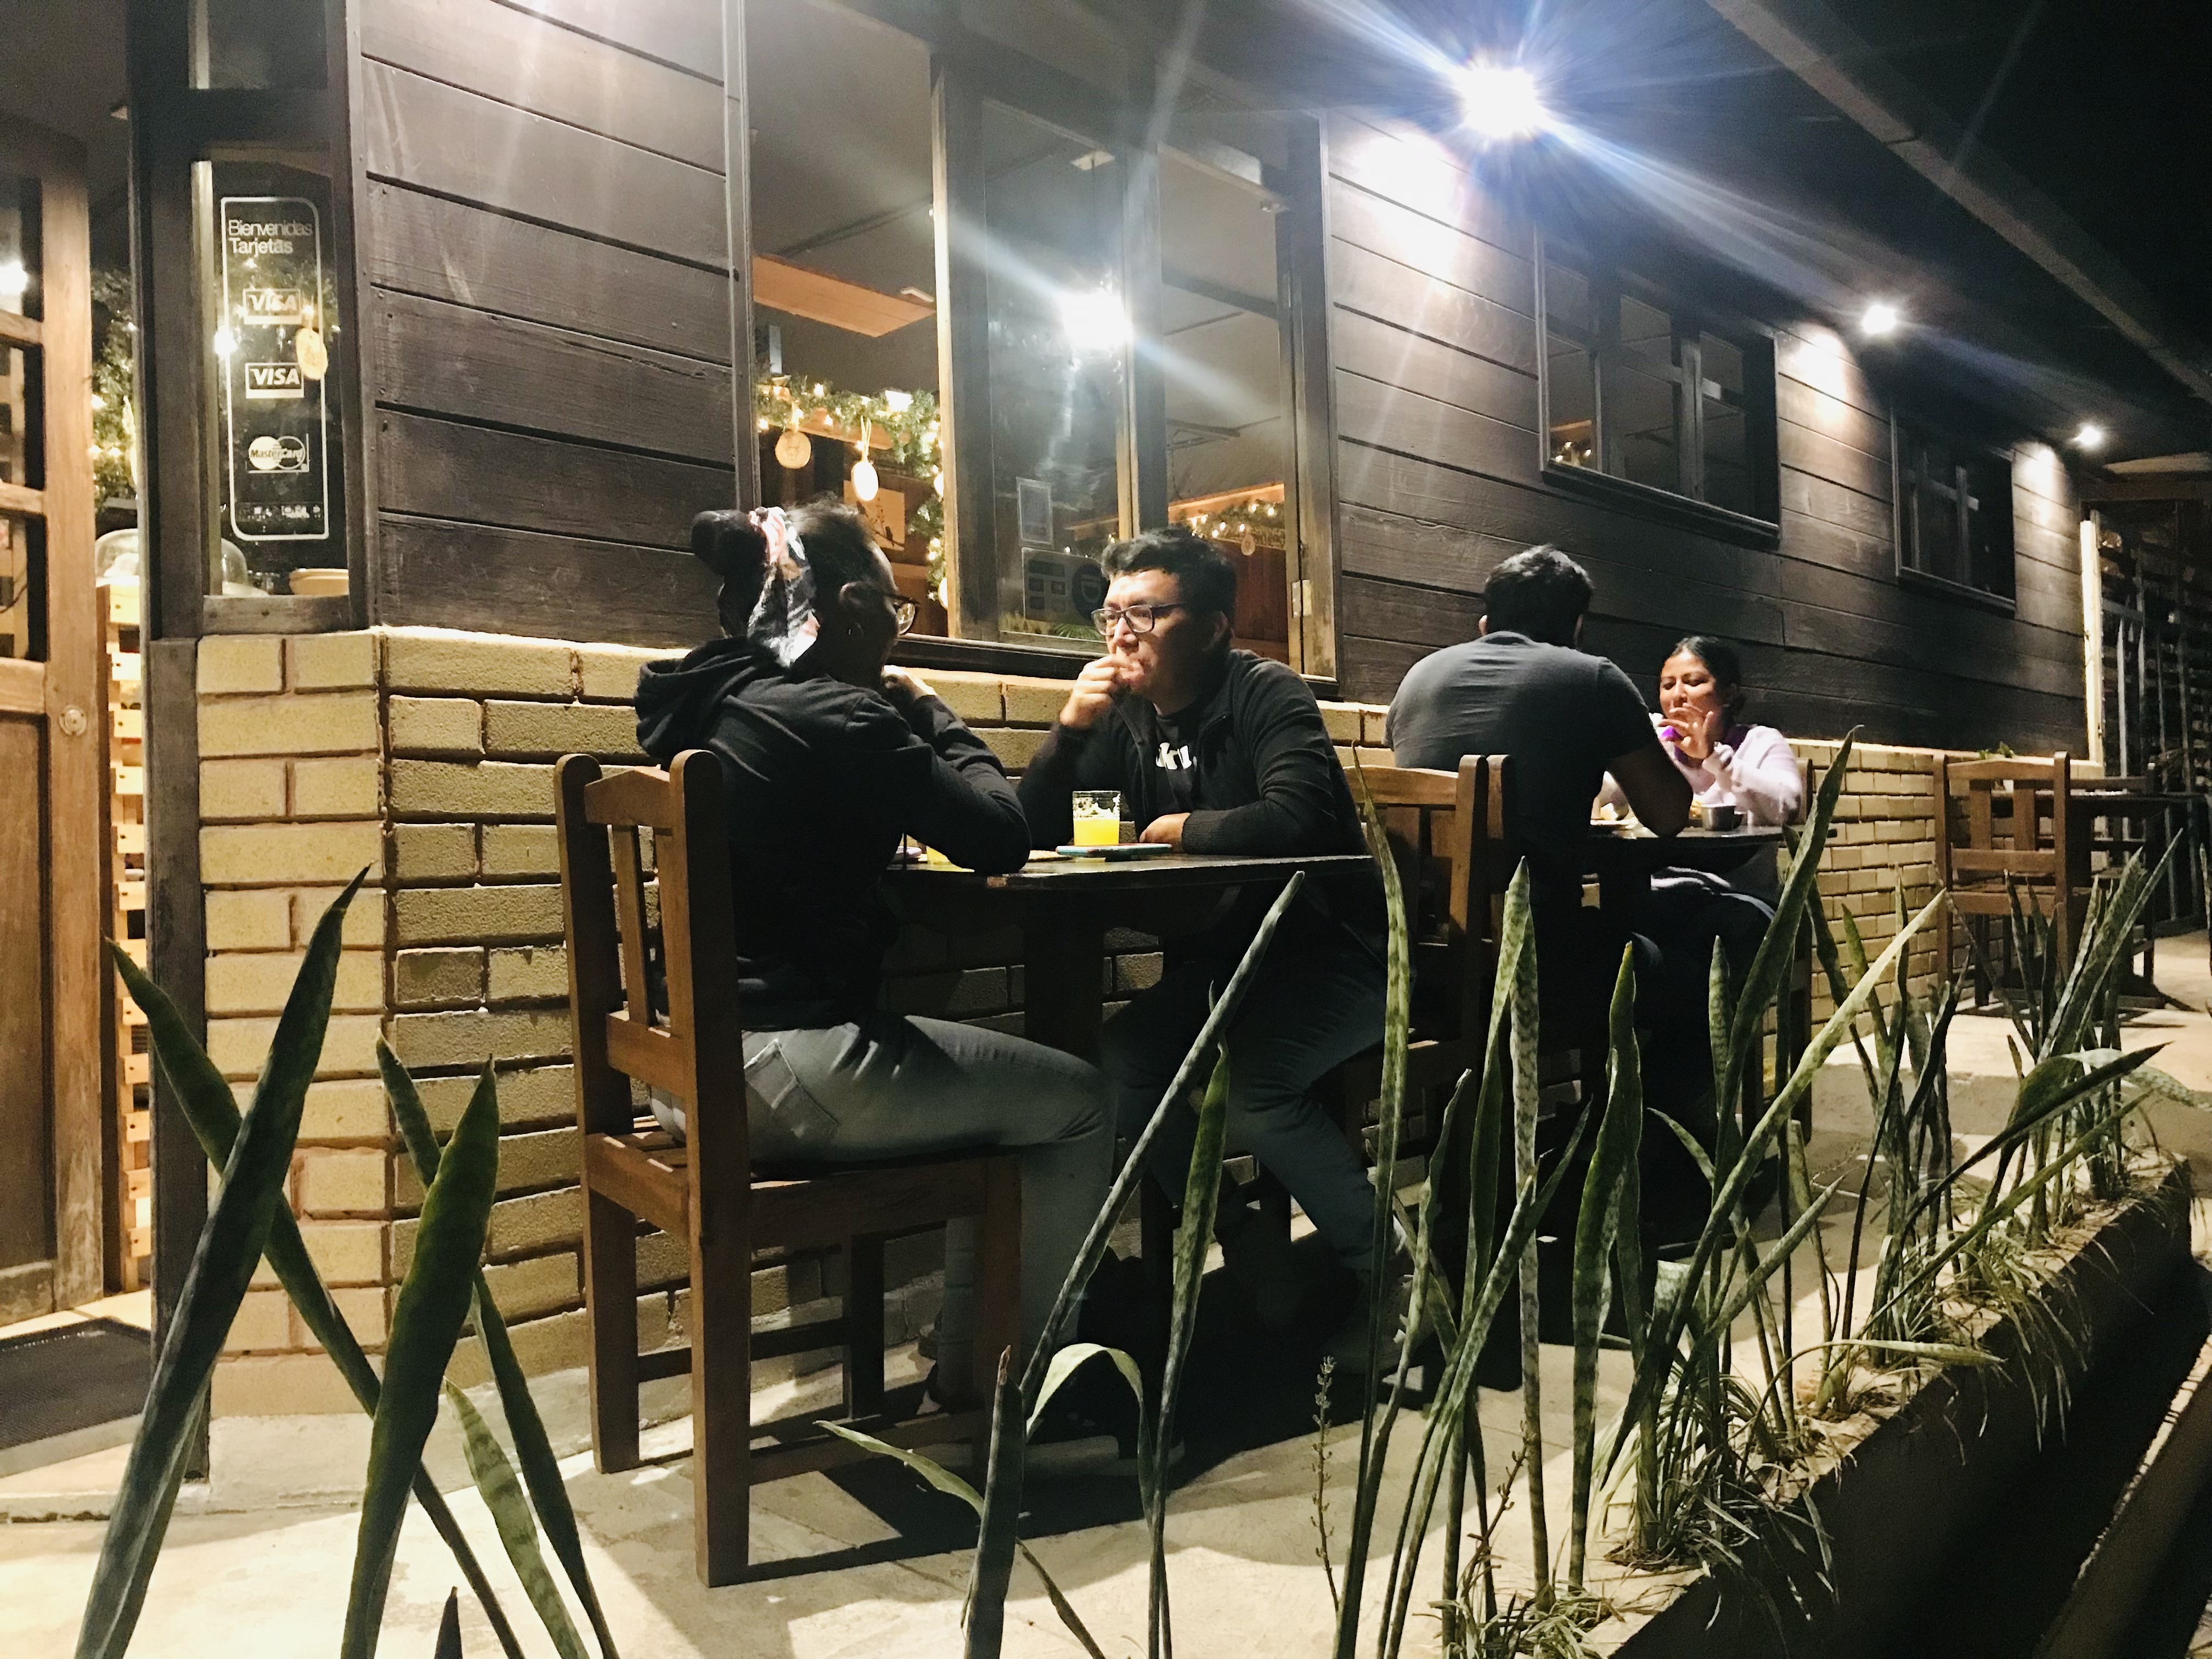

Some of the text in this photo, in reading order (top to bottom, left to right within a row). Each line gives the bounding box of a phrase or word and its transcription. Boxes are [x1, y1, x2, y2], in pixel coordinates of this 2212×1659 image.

[228, 220, 313, 236] Bienvenidas
[229, 238, 293, 257] Tarjetas
[249, 295, 297, 311] VISA
[251, 368, 300, 385] VISA
[250, 448, 303, 461] MasterCard
